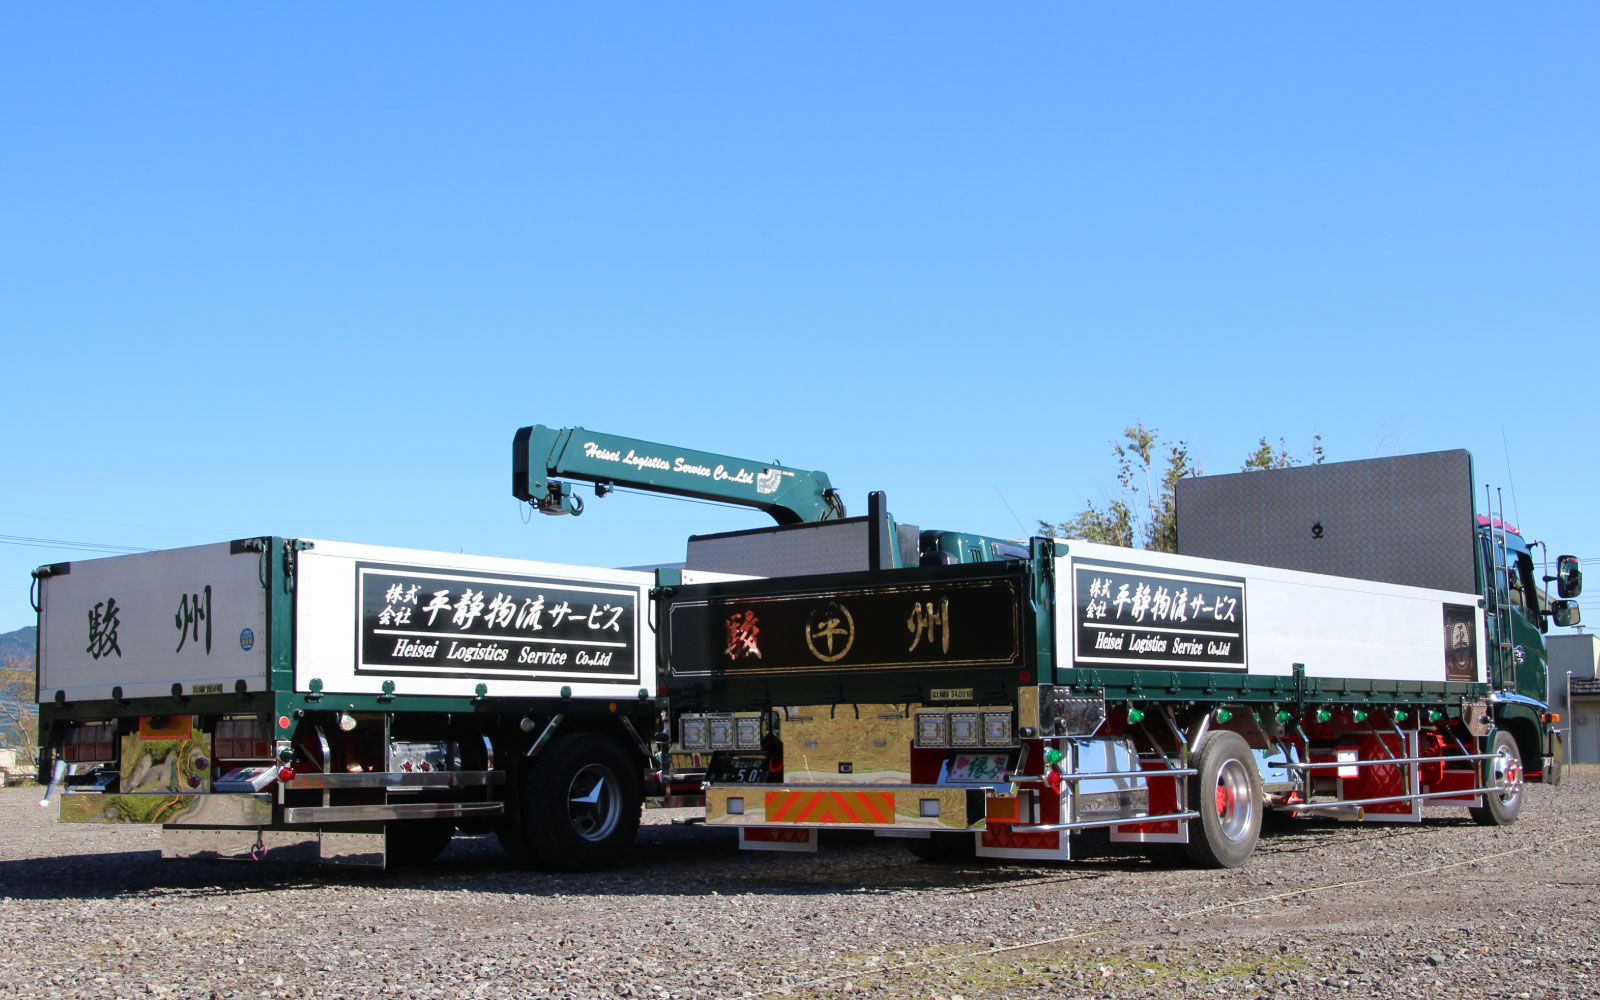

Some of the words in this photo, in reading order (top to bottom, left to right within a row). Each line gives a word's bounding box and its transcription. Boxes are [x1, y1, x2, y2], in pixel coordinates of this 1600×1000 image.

[583, 441, 621, 462] Heisei
[622, 449, 671, 471] Logistics
[673, 457, 711, 477] Service
[384, 582, 422, 605] 株式
[1112, 581, 1237, 623] 平静物流サービス
[377, 604, 412, 627] 会社
[422, 587, 624, 632] 平静物流サービス
[391, 638, 440, 659] Heisei
[446, 641, 509, 663] Logistics
[517, 646, 568, 665] Service
[1094, 631, 1125, 650] Heisei
[1128, 633, 1168, 654] Logistics
[1171, 637, 1203, 656] Service
